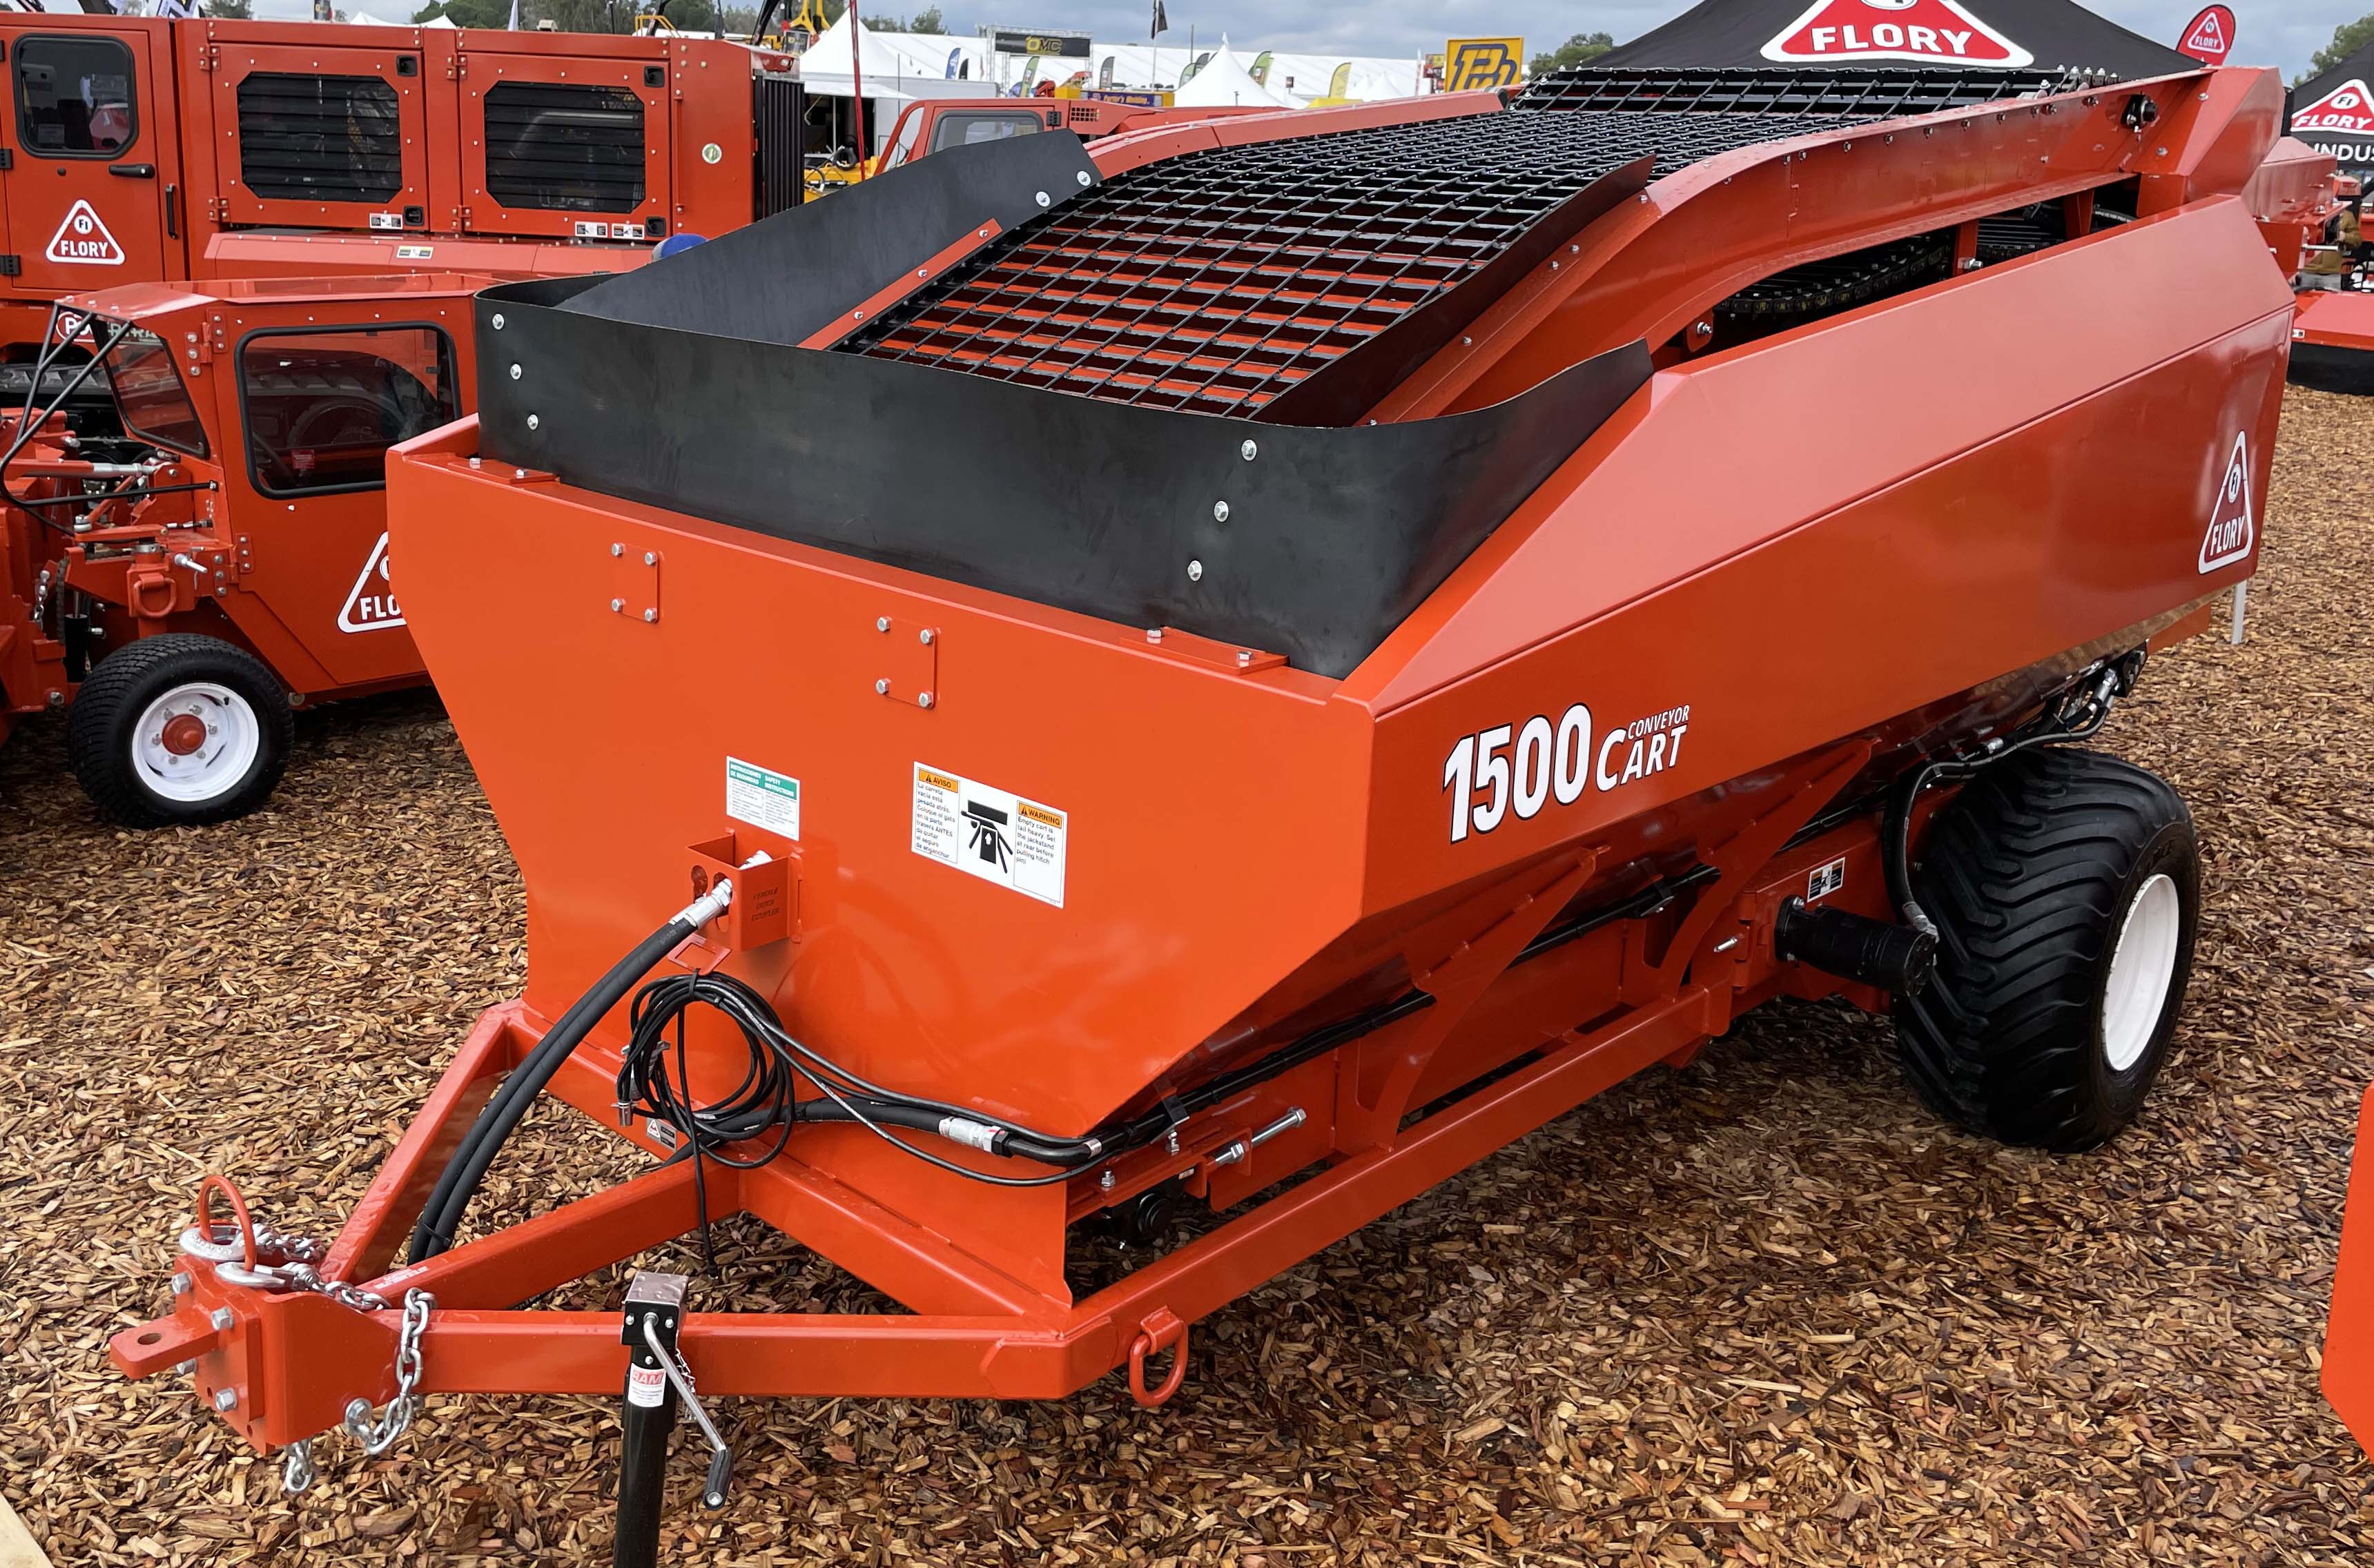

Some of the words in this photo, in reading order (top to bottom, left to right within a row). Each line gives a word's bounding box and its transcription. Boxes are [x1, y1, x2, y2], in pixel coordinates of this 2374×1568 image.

[1026, 36, 1062, 53] OMC
[1811, 23, 1972, 55] FLORY
[2195, 35, 2219, 48] FLORY
[2337, 96, 2353, 106] FI
[2295, 114, 2373, 130] FLORY
[79, 219, 88, 231] FI
[61, 240, 108, 257] FLORY
[2230, 471, 2239, 495] FI
[2210, 516, 2245, 556] FLORY
[1628, 705, 1690, 740] CONVEYOR
[1443, 703, 1592, 844] 1500
[1595, 725, 1687, 792] CART
[925, 785, 943, 795] carreta
[933, 776, 951, 788] AVISO
[1018, 816, 1035, 828] Empty
[1036, 822, 1047, 830] cart
[1029, 808, 1060, 825] WARNING
[935, 826, 953, 837] ANTES
[1017, 832, 1027, 841] the
[1027, 835, 1054, 850] jackstand
[1016, 848, 1035, 861] pulling
[1035, 854, 1050, 865] hitch
[1023, 843, 1035, 851] rear
[1035, 845, 1054, 859] before
[632, 1369, 663, 1385] RAM
